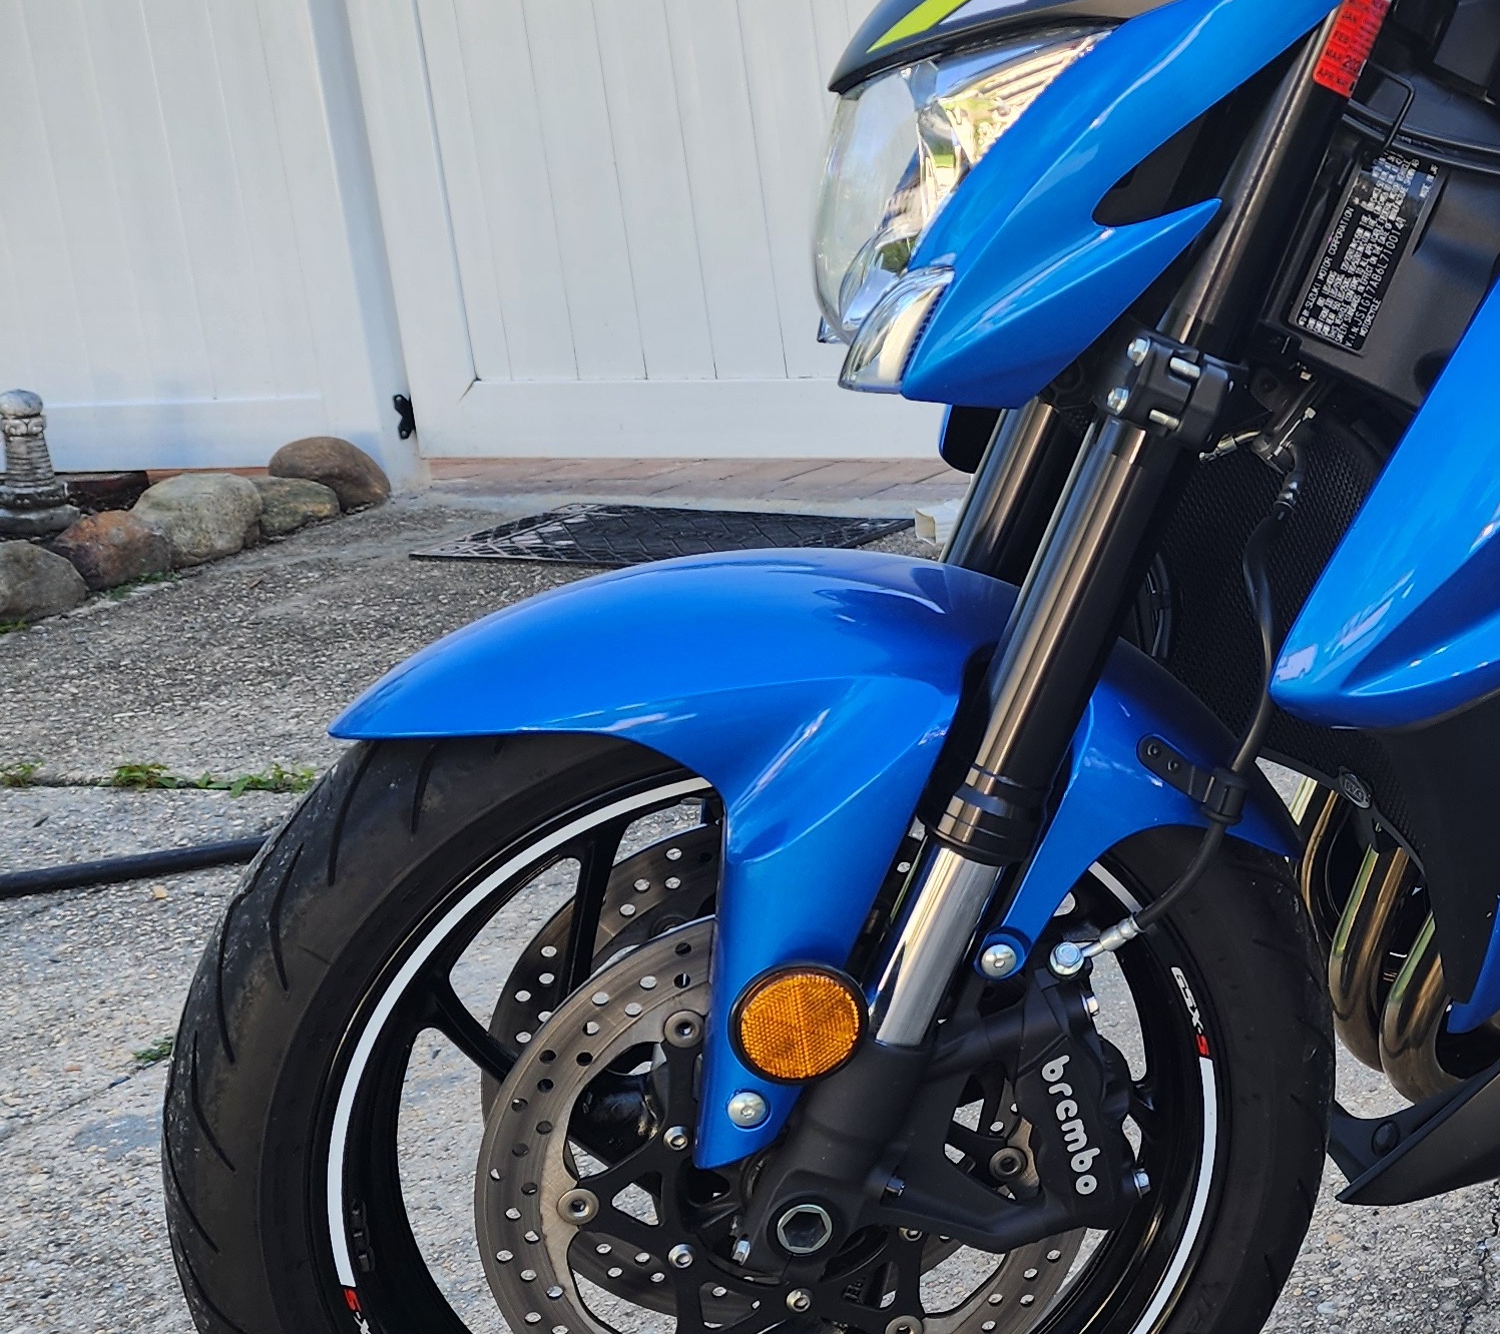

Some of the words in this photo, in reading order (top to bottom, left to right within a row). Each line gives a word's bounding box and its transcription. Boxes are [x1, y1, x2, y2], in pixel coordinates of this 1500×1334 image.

[1304, 282, 1321, 309] SUZUKI
[1317, 256, 1332, 280] MOTOR
[1327, 205, 1354, 255] CORPORATION
[1170, 965, 1212, 1058] GSX-S
[1041, 1054, 1101, 1195] brembo
